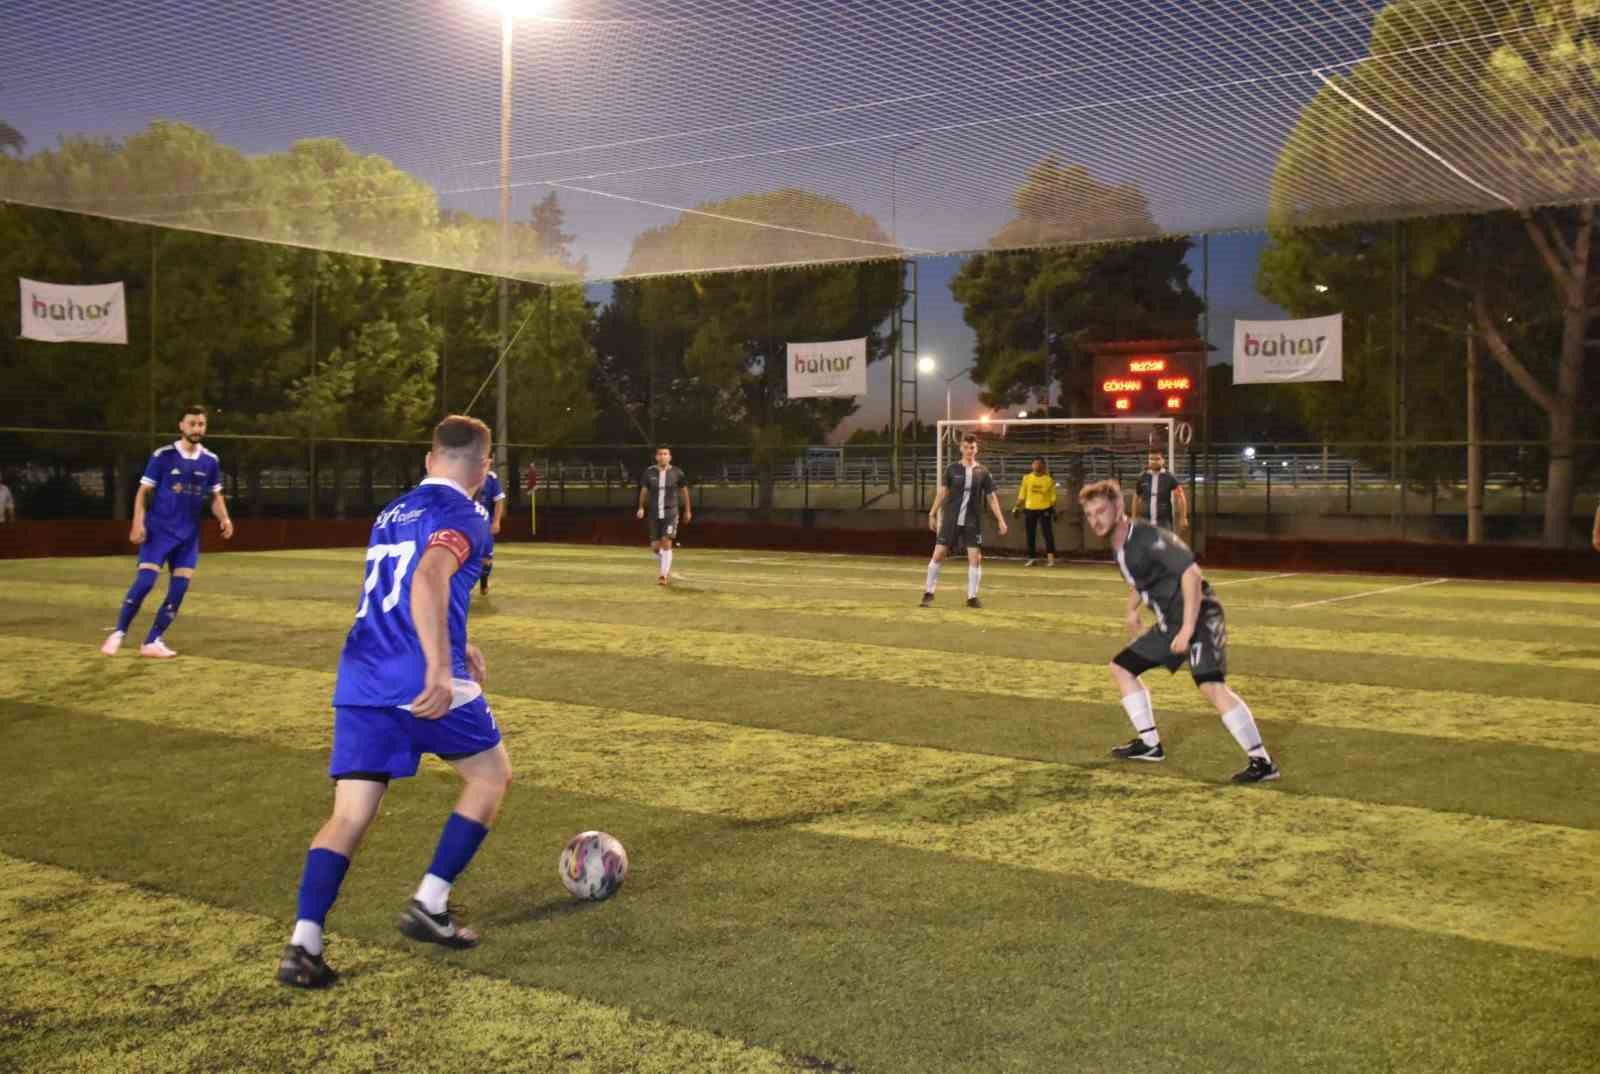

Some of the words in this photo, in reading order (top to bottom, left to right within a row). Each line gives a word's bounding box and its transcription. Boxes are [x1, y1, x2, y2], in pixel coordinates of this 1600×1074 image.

[31, 292, 111, 321] bahar
[1244, 332, 1326, 357] bahar
[355, 540, 416, 618] 77
